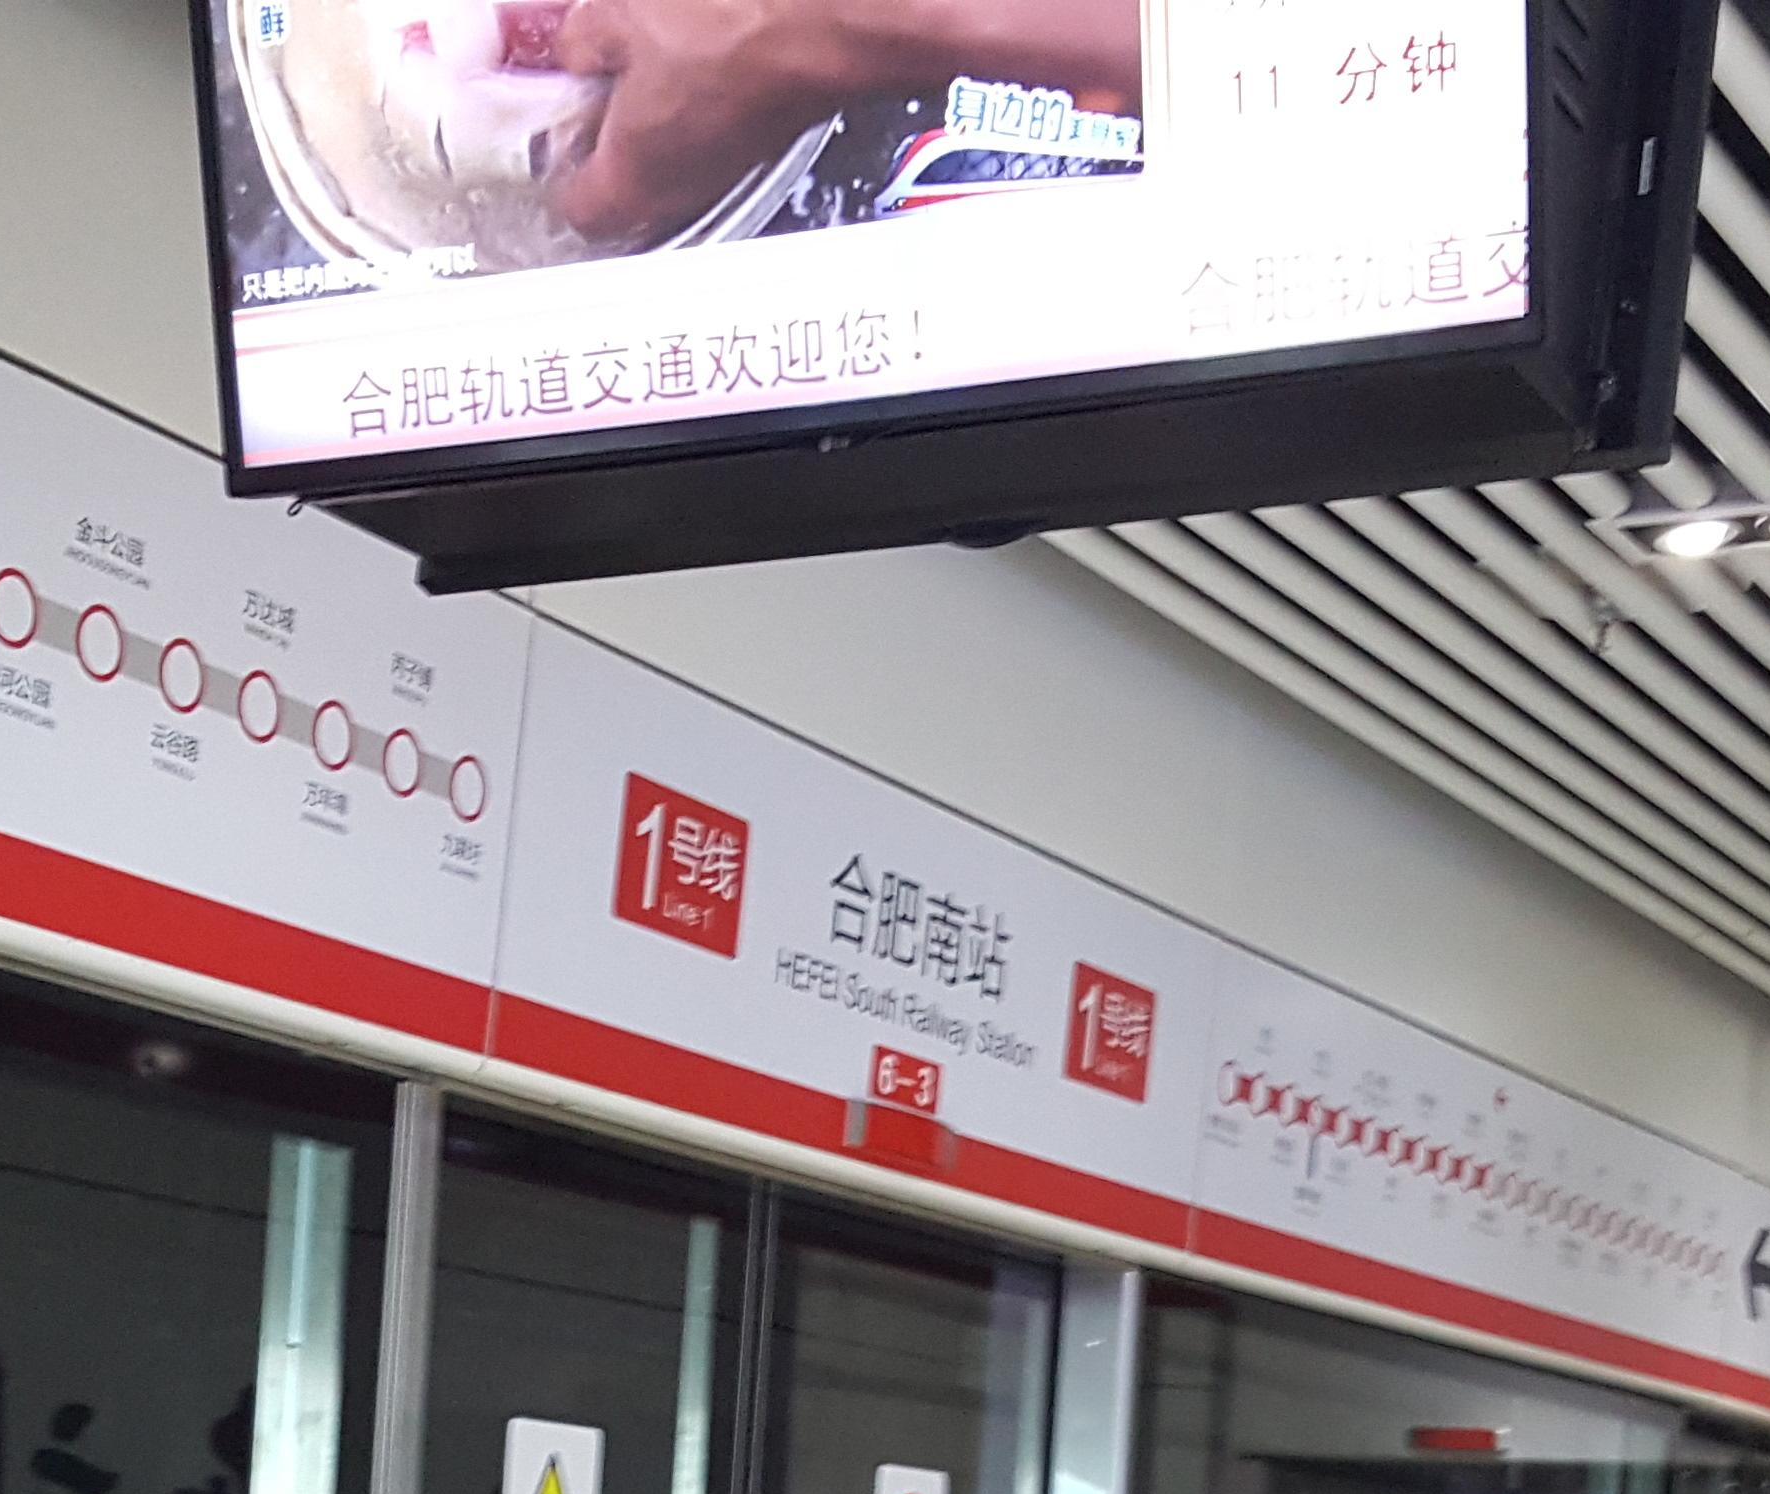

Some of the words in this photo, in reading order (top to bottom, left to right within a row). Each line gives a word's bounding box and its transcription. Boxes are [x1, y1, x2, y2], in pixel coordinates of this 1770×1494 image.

[1233, 65, 1278, 114] 11
[1336, 31, 1456, 104] 分钟
[341, 309, 924, 439] 合肥轨道交通欢迎您！
[635, 801, 741, 912] 1号线
[830, 851, 1013, 1003] 合肥南站
[774, 947, 838, 1001] HEFEI
[842, 971, 897, 1024] South
[1077, 982, 1151, 1072] 1号线
[876, 1054, 937, 1108] 6-3
